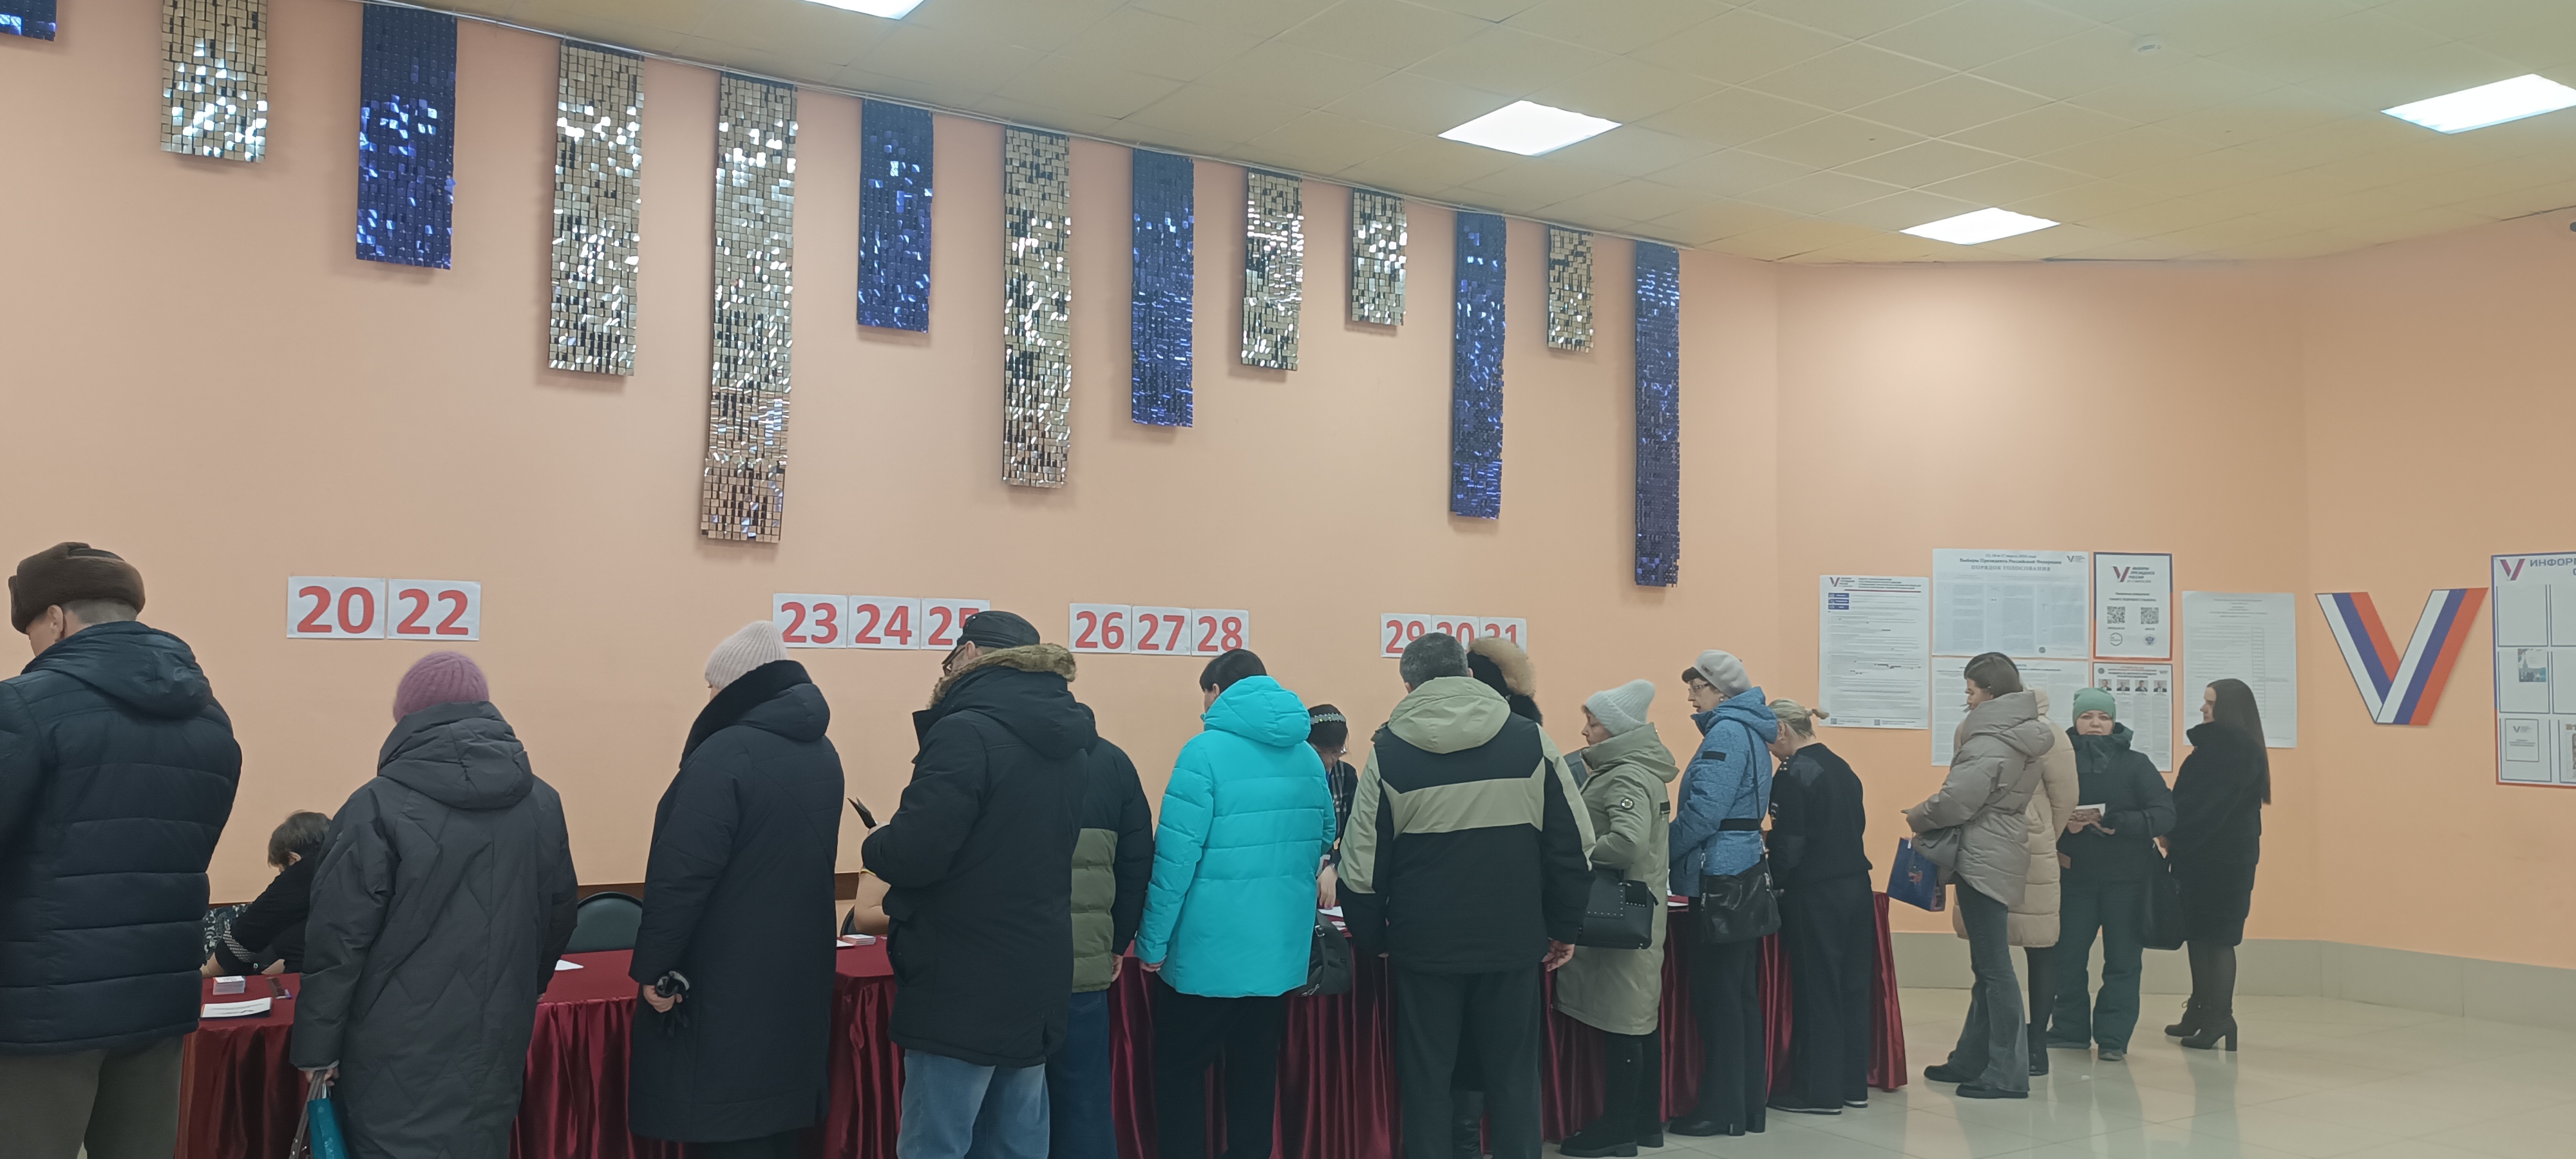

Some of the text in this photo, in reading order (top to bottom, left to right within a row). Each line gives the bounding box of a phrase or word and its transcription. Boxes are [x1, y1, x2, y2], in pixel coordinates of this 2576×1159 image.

[298, 586, 469, 636] 20 22
[781, 602, 838, 644] 23
[854, 604, 912, 645] 24
[1075, 610, 1243, 652] 26 27 28
